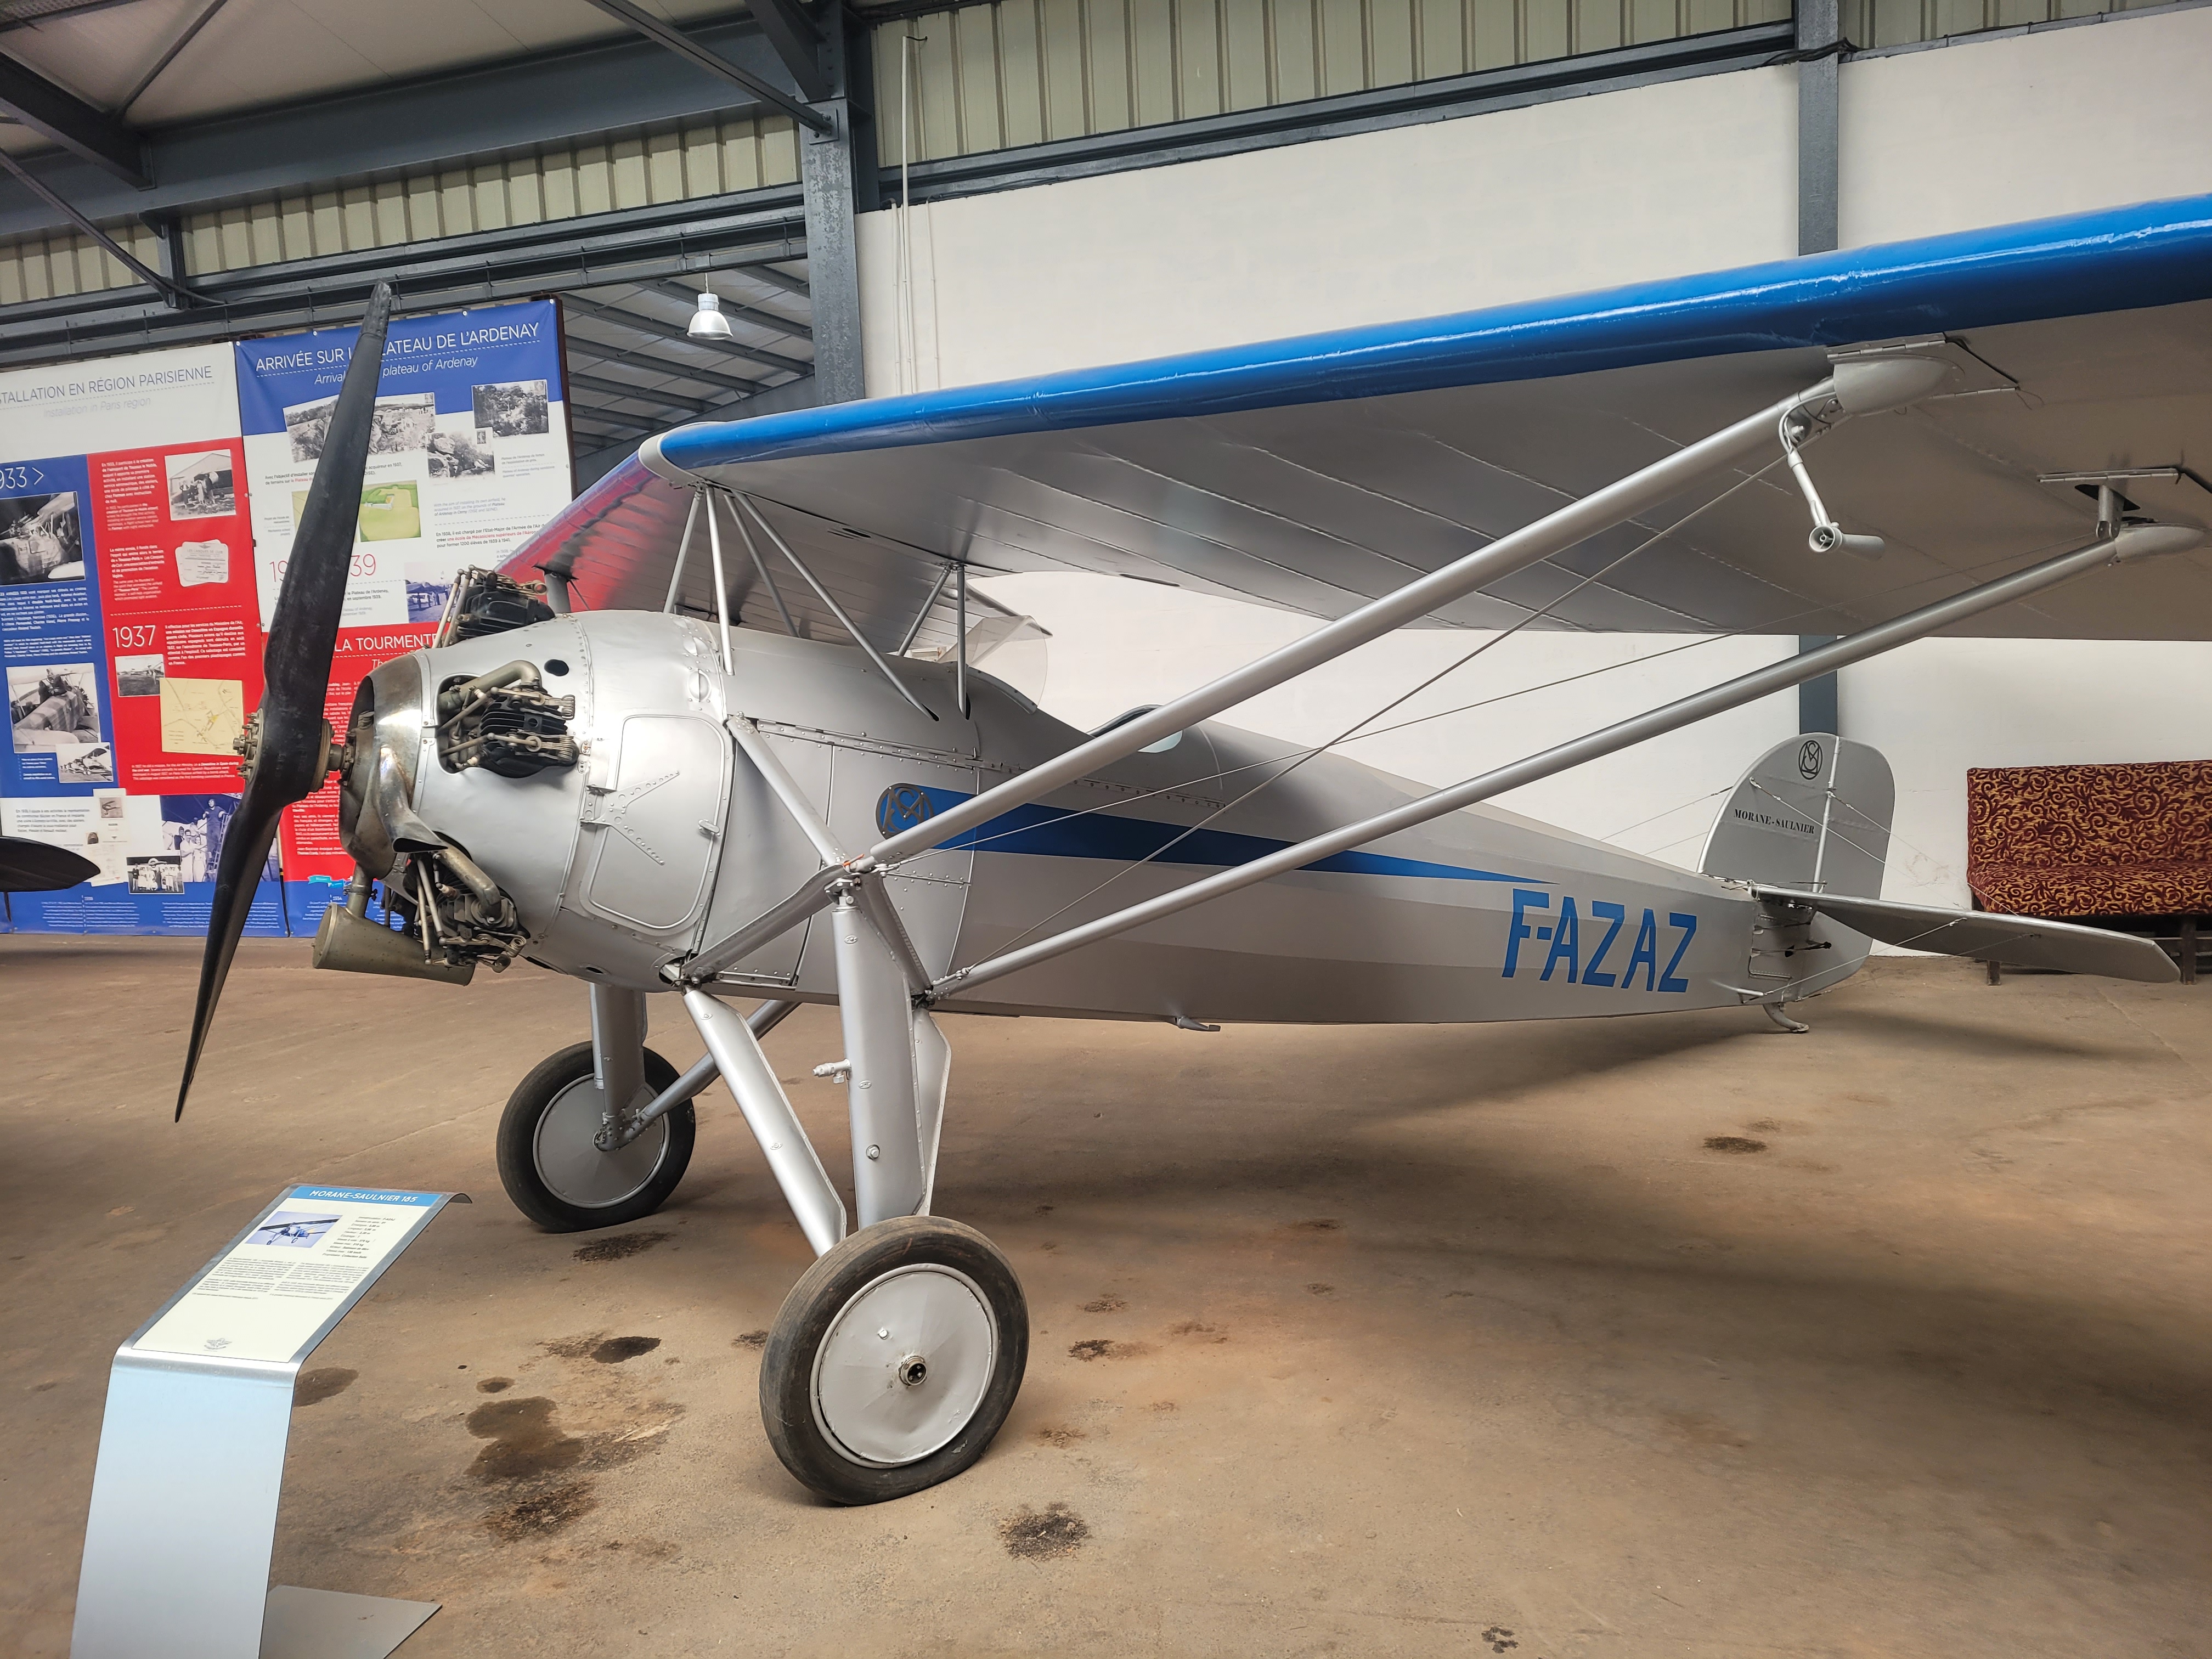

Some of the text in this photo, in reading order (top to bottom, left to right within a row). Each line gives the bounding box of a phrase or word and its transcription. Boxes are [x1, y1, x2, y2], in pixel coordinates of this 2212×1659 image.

[256, 351, 313, 371] ARRIVÉE
[317, 348, 345, 364] SUR
[382, 336, 432, 356] ATEAU
[437, 334, 456, 349] DE
[461, 323, 539, 346] L'ARDENAY
[69, 382, 84, 395] EN
[89, 376, 135, 393] RÉGION
[139, 366, 212, 386] PARISIENNE
[314, 357, 478, 385] Arrival plateau of Ardenay
[43, 405, 87, 417] Installation
[100, 401, 121, 410] Paris
[123, 398, 150, 409] region
[112, 625, 155, 647] 1937
[334, 639, 353, 652] LA
[1734, 809, 1814, 834] MORANE-SAULNIER
[1502, 888, 1697, 993] F-AZAZ
[309, 1190, 400, 1201] MORANE-SAULNIER
